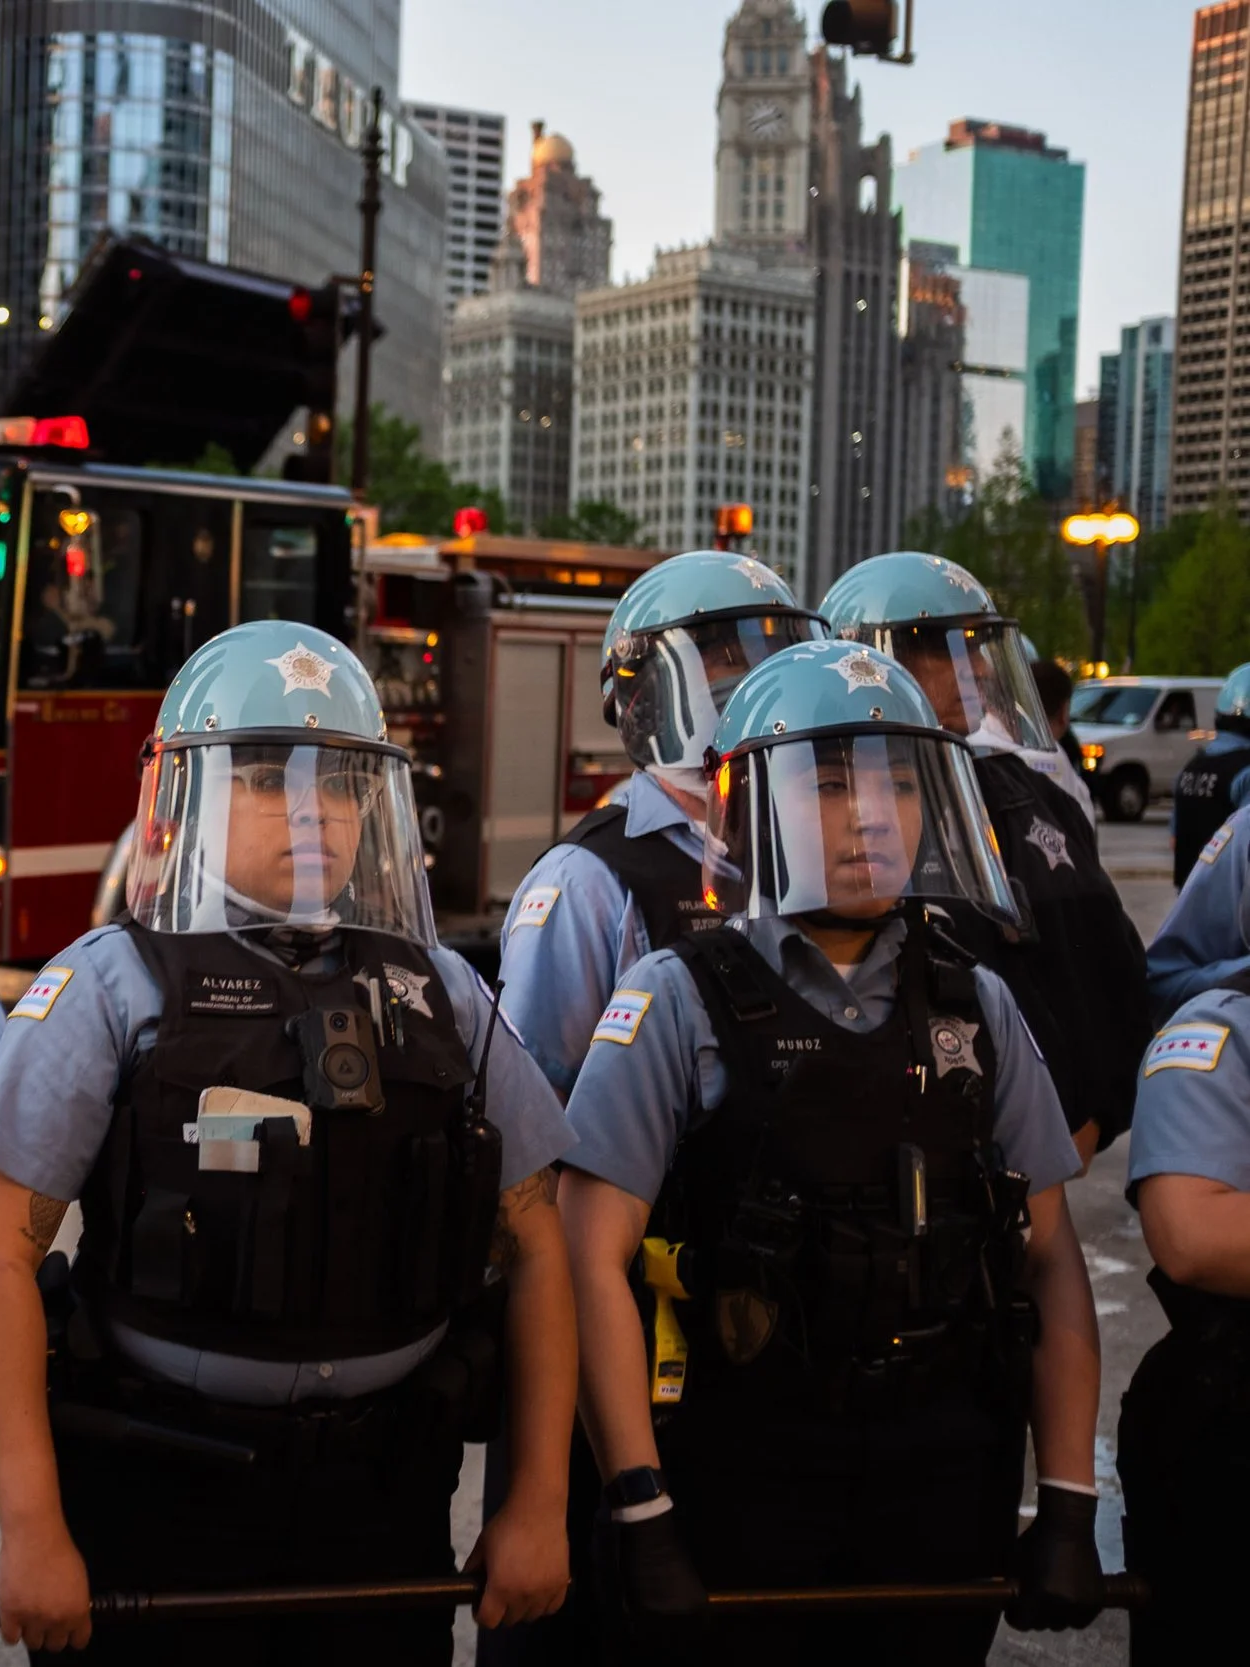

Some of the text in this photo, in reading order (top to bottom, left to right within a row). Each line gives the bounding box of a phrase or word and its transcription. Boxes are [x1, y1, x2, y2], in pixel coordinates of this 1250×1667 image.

[202, 976, 262, 991] ALVAREZ
[210, 993, 254, 1004] BUREAU OF
